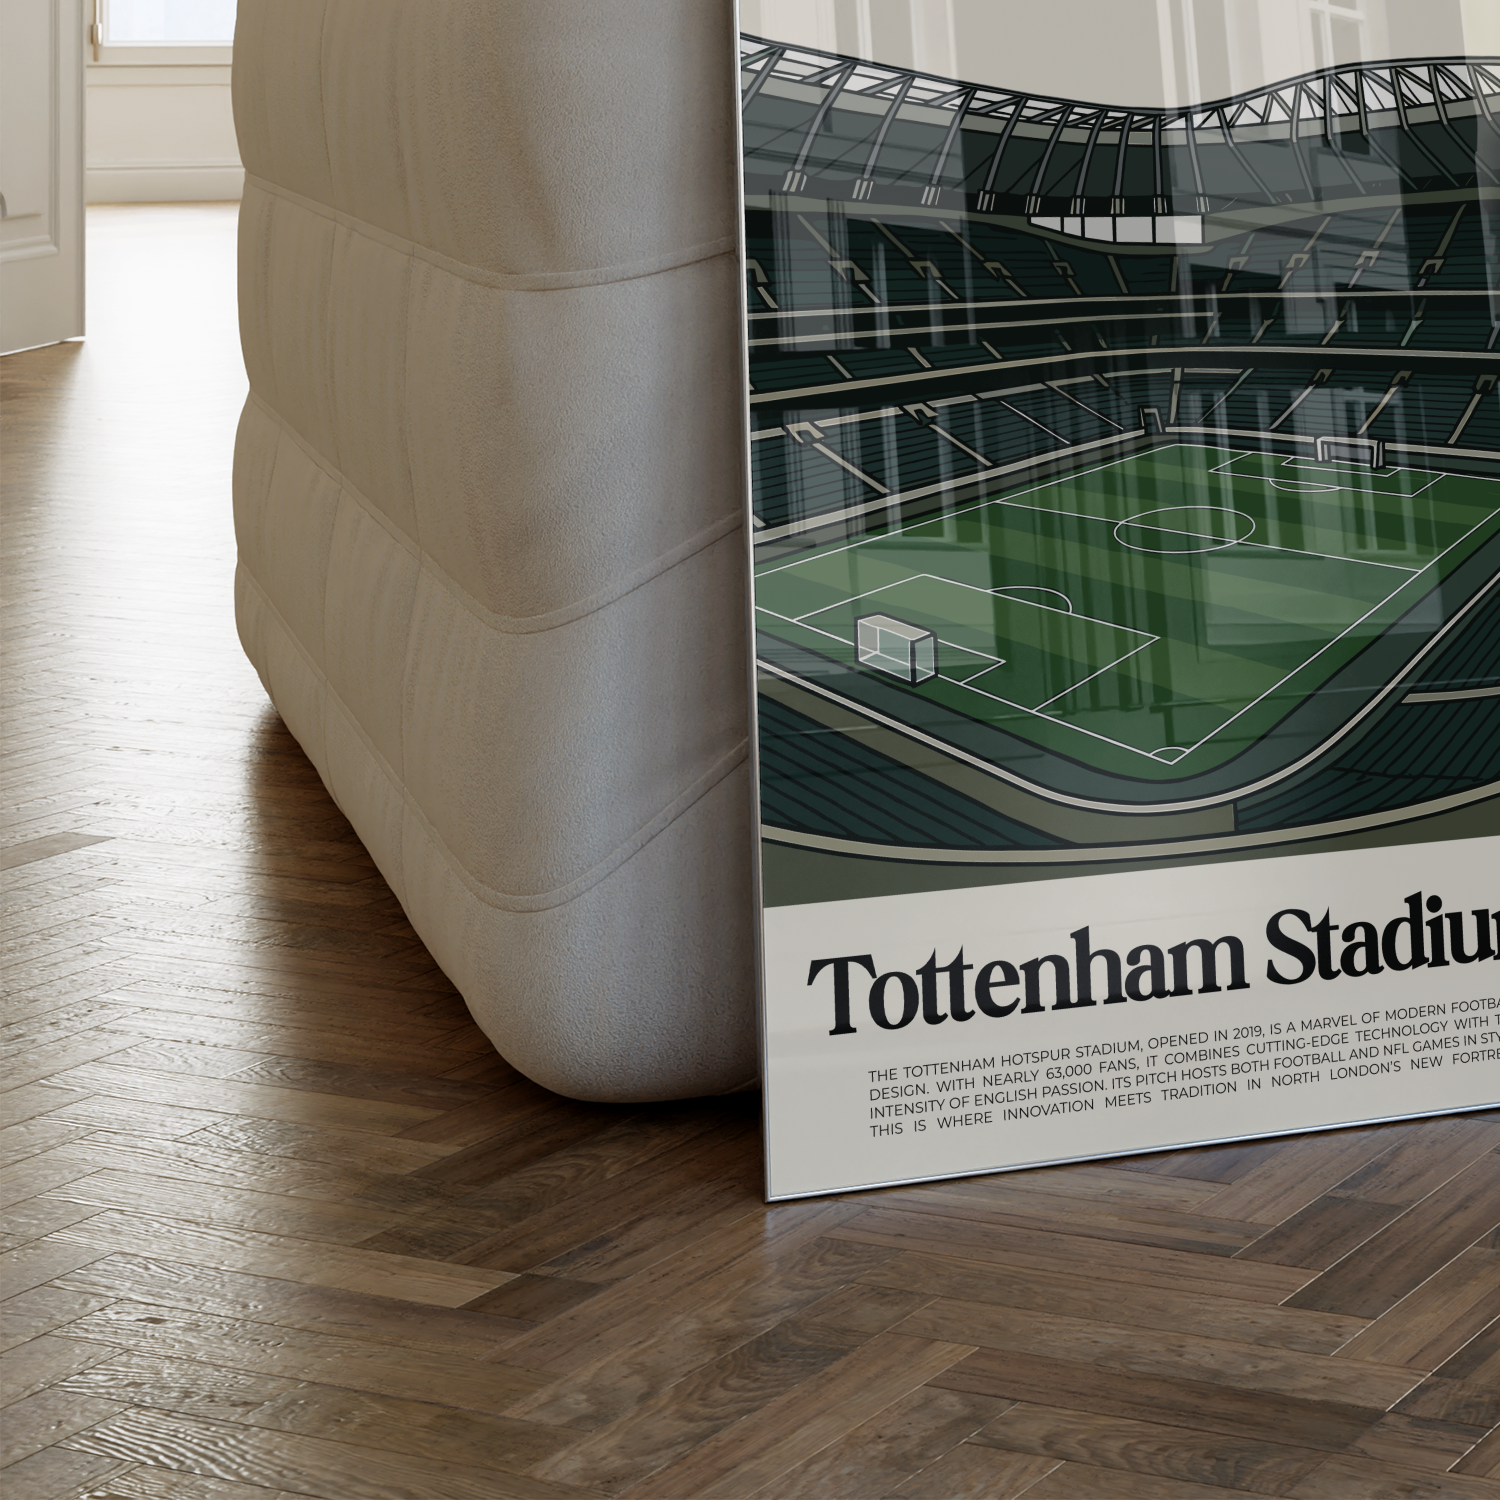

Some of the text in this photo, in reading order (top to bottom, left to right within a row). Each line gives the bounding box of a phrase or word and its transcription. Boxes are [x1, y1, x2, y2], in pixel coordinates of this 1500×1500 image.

[805, 925, 1251, 1037] Tottenham
[867, 1067, 898, 1083] THE
[902, 1056, 995, 1079] TOTTENHAM
[1001, 1047, 1071, 1068] HOTSPUR
[1075, 1039, 1144, 1059] STADIUM,
[1147, 1031, 1209, 1050] OPENED
[1214, 1029, 1228, 1042] IN
[1232, 1025, 1265, 1040] 2019,
[1270, 1022, 1282, 1036] IS
[1285, 1021, 1297, 1034] A
[1300, 1014, 1358, 1032] MARVEL
[1361, 1010, 1381, 1024] OF
[1385, 1003, 1446, 1022] MODERN
[869, 1082, 930, 1102] DESIGN.
[935, 1076, 975, 1093] WITH
[982, 1069, 1040, 1088] NEARLY
[1045, 1062, 1093, 1080] 63,000
[1099, 1057, 1140, 1074] FANS,
[1146, 1054, 1158, 1068] IT
[1164, 1045, 1240, 1066] COMBINES
[1246, 1032, 1349, 1056] CUTTING-EDGE
[1354, 1020, 1449, 1043] TECHNOLOGY
[1453, 1015, 1489, 1031] WITH
[870, 1098, 946, 1120] INTENSITY
[948, 1095, 970, 1110] OF
[974, 1087, 1038, 1107] ENGLISH
[1042, 1079, 1108, 1098] PASSION.
[1111, 1075, 1132, 1090] ITS
[1135, 1070, 1177, 1087] PITCH
[1181, 1064, 1227, 1081] HOSTS
[1231, 1059, 1270, 1075] BOTH
[1273, 1050, 1346, 1070] FOOTBALL
[1348, 1046, 1380, 1061] AND
[1383, 1042, 1410, 1056] NFL
[1412, 1035, 1460, 1053] GAMES
[1463, 1033, 1477, 1047] IN
[869, 1122, 904, 1138] THIS
[914, 1119, 927, 1133] IS
[936, 1110, 993, 1129] WHERE
[1003, 1098, 1094, 1121] INNOVATION
[1105, 1091, 1152, 1109] MEETS
[1160, 1080, 1237, 1101] TRADITION
[1247, 1077, 1261, 1091] IN
[1271, 1070, 1320, 1088] NORTH
[1330, 1060, 1402, 1081] LONDON'S
[1410, 1055, 1443, 1071] NEW
